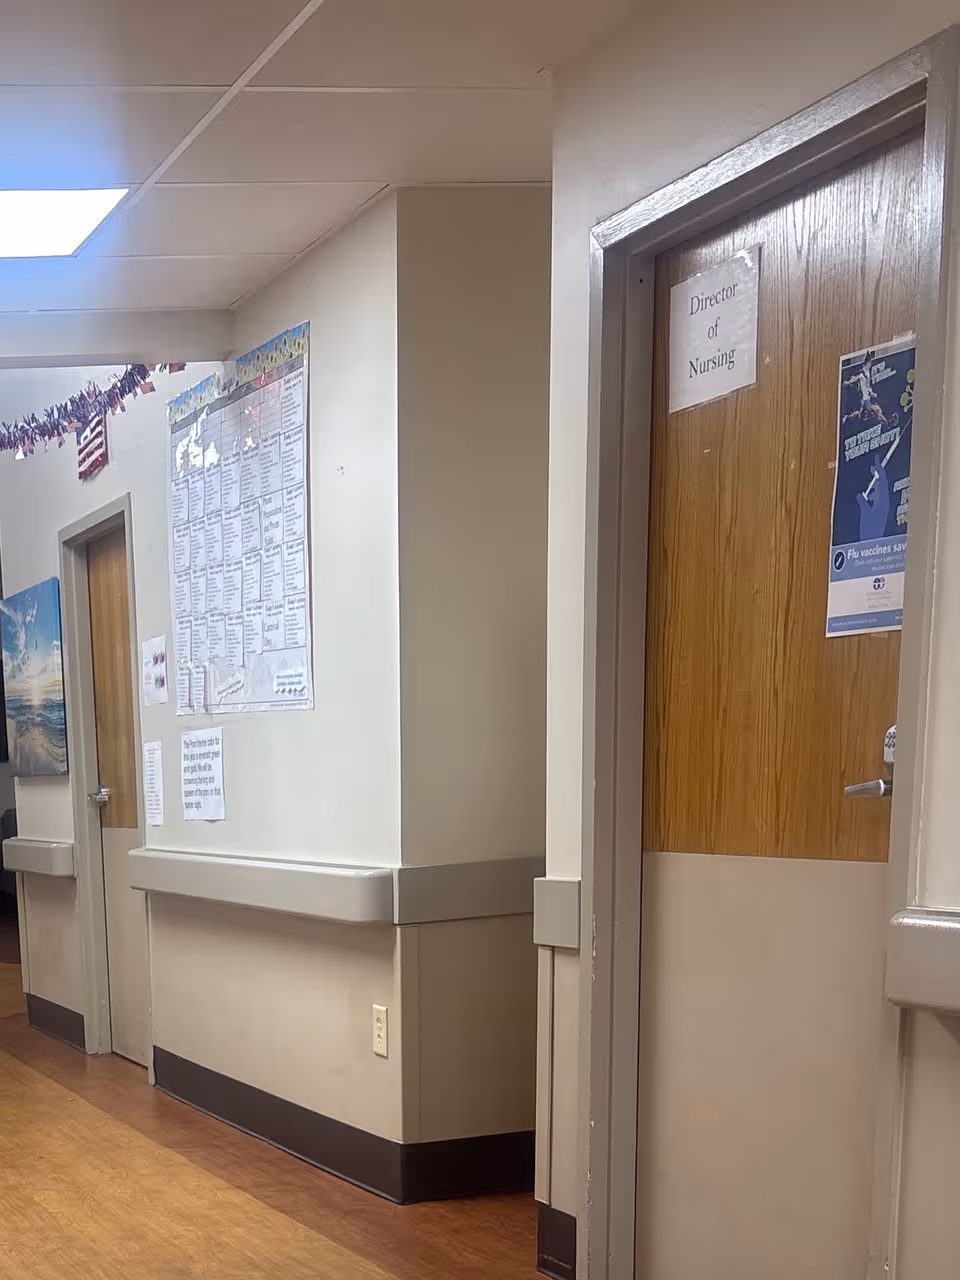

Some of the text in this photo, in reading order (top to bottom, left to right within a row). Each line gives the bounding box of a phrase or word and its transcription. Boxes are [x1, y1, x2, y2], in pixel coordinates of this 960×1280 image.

[689, 283, 738, 316] Director
[707, 317, 720, 339] of
[688, 348, 735, 378] Nursing
[844, 423, 882, 451] TO TAKE
[844, 441, 870, 462] YOUR
[847, 542, 907, 560] Flu vaccines sav
